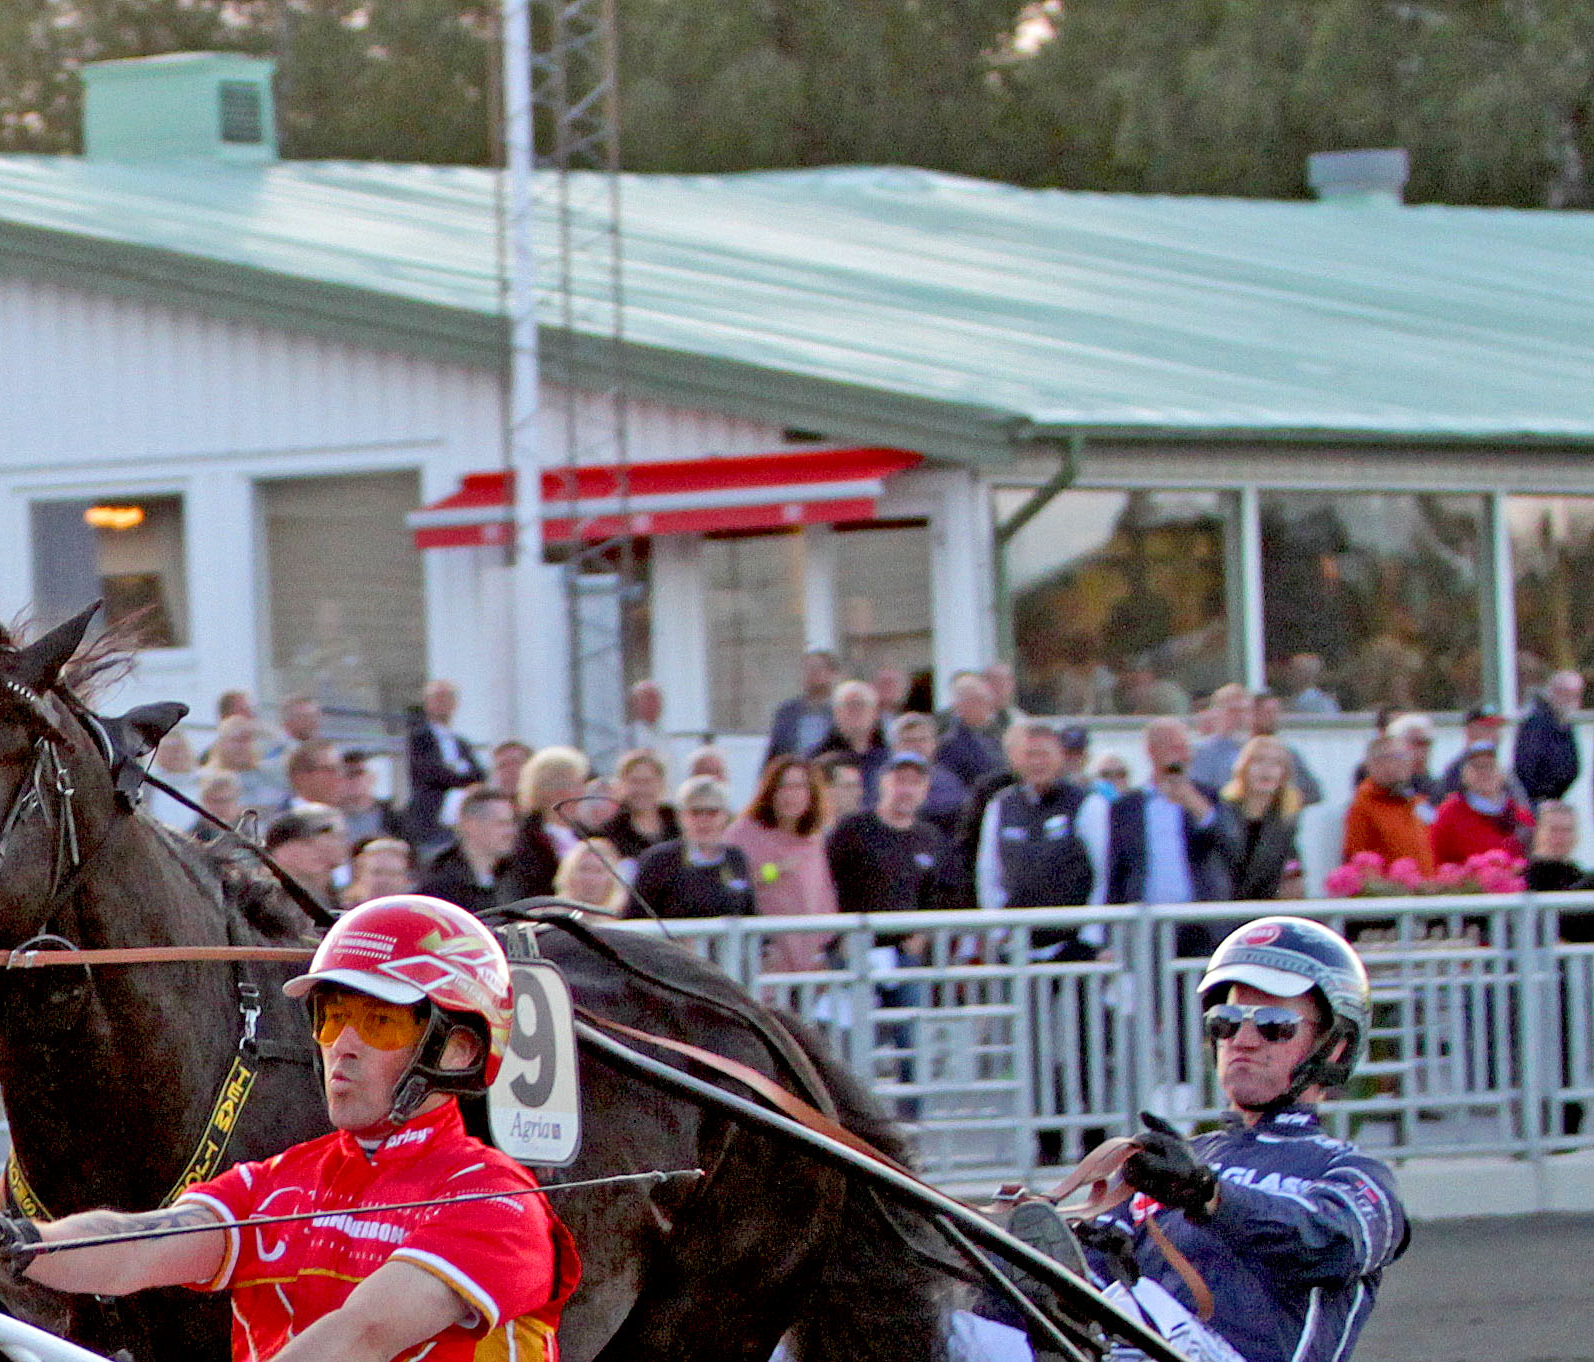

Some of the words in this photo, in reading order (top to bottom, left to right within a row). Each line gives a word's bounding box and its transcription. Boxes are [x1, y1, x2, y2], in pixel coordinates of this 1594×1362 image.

[509, 968, 556, 1108] 9
[214, 1065, 252, 1133] TEAM
[510, 1112, 550, 1143] Agria
